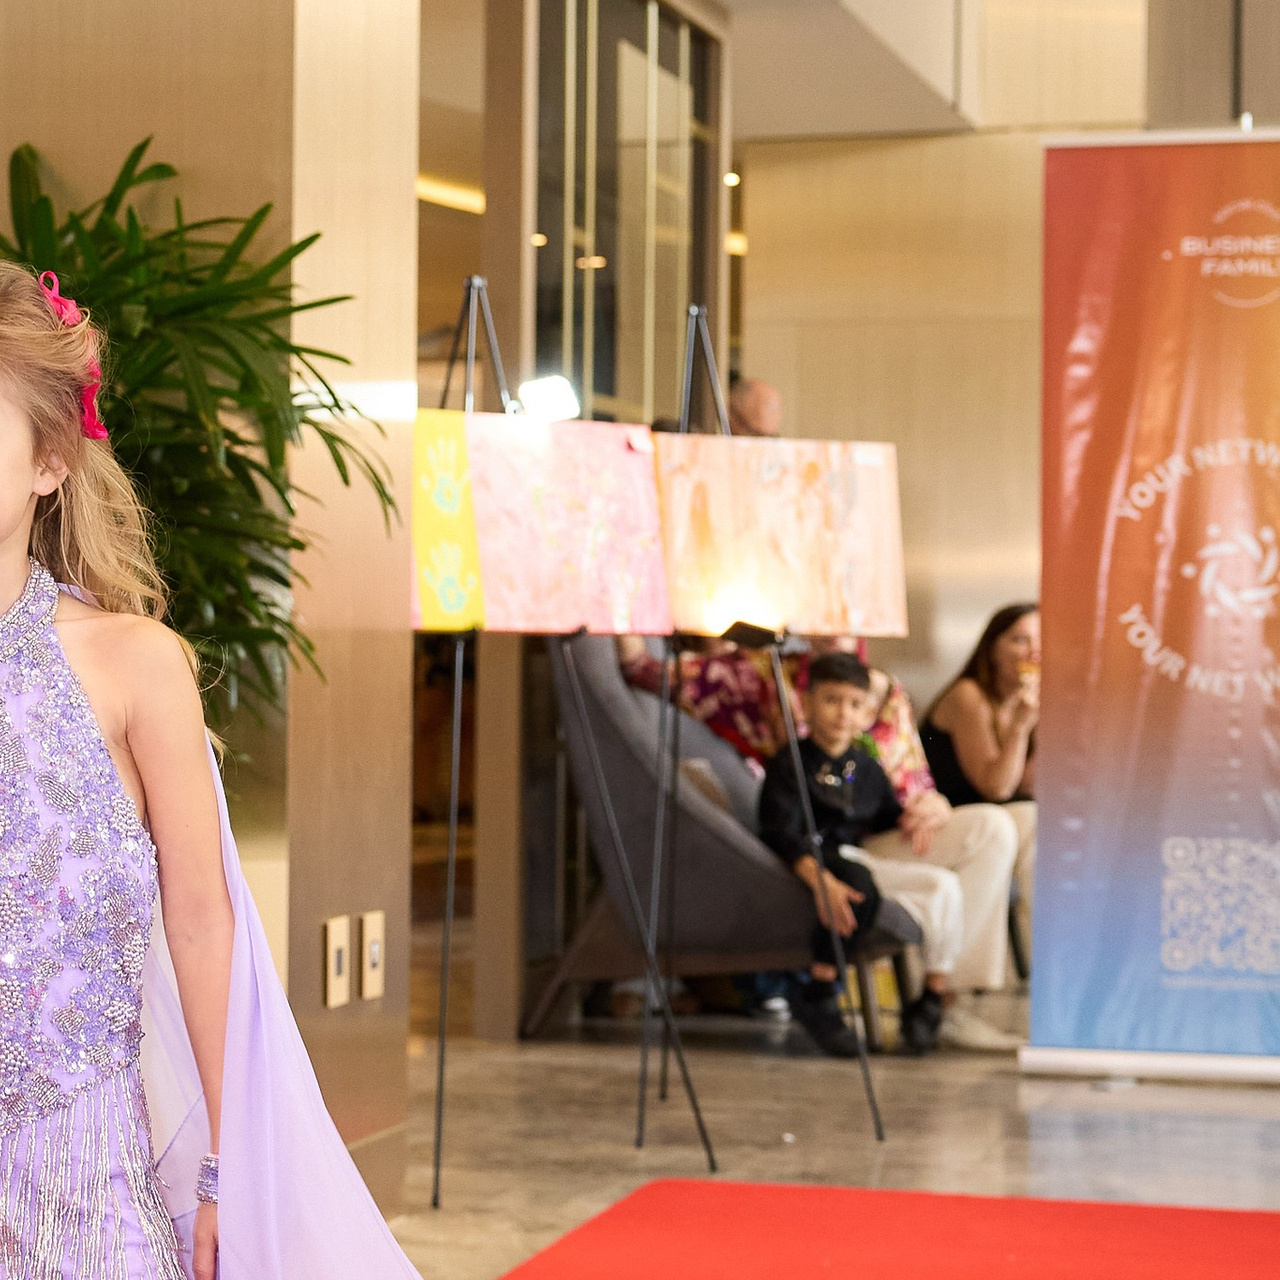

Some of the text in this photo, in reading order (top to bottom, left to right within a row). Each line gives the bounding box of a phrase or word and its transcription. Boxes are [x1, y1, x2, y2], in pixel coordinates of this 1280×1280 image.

[1200, 257, 1280, 277] FAMIL
[1114, 453, 1192, 521] YOUR
[1118, 603, 1187, 682] YOUR
